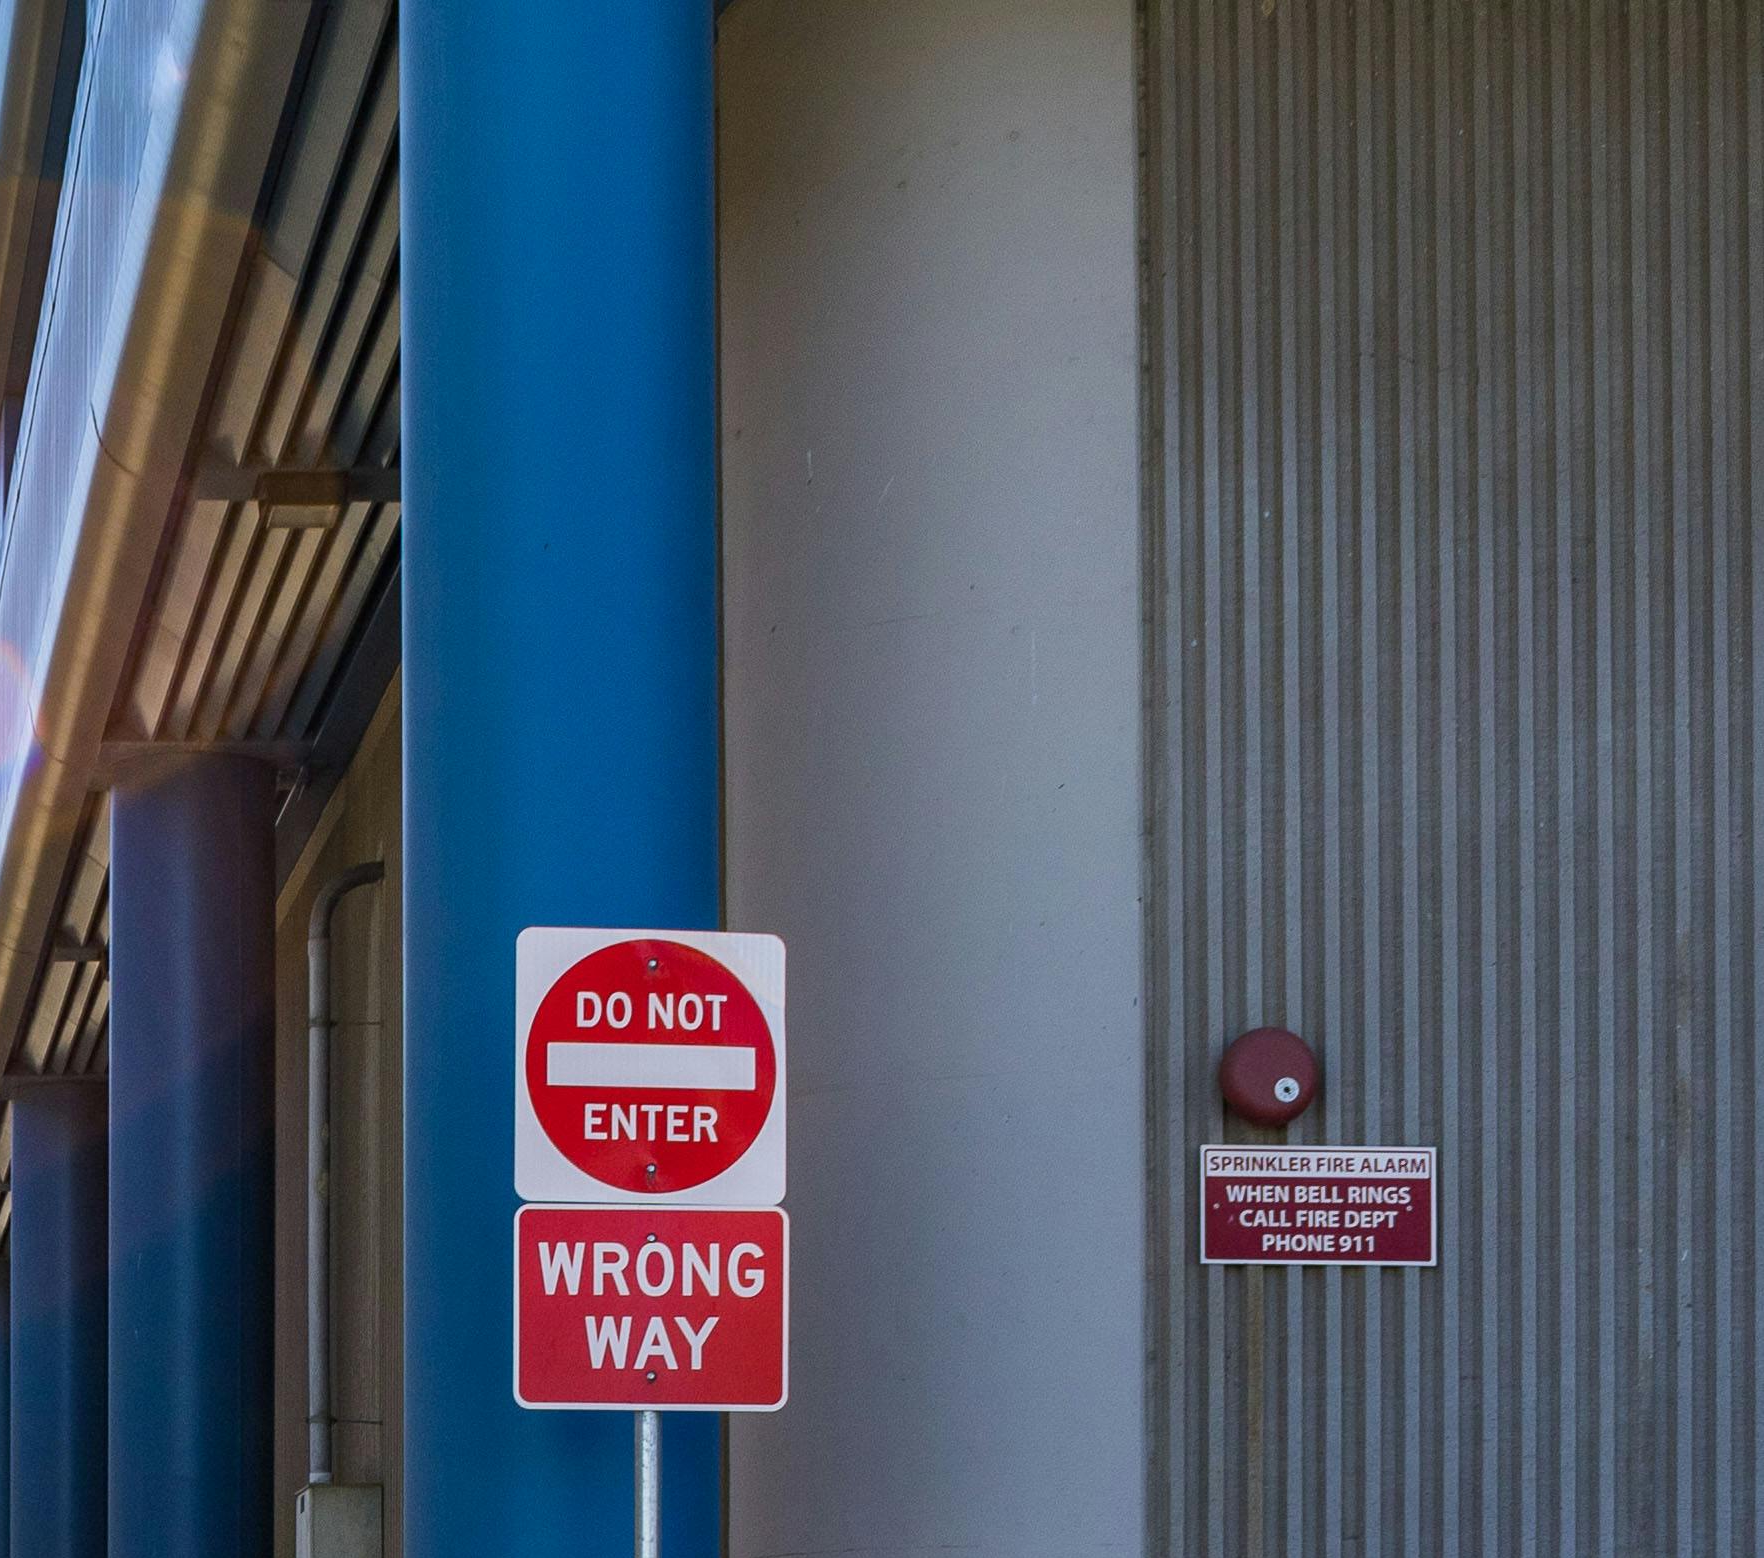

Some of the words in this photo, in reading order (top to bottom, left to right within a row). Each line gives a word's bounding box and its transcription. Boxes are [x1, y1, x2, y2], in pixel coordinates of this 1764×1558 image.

[575, 991, 633, 1029] DO
[647, 993, 728, 1031] NOT
[583, 1103, 719, 1143] ENTER
[1209, 1156, 1311, 1172] SPRINKLER
[1316, 1157, 1354, 1172] FIRE
[1360, 1158, 1426, 1173] ALARM
[1226, 1185, 1289, 1203] WHEN
[1294, 1186, 1343, 1203] BELL
[1347, 1186, 1411, 1204] RINGS
[1239, 1209, 1291, 1227] CALL
[1295, 1210, 1340, 1228] FIRE
[1344, 1211, 1398, 1228] DEPT
[1262, 1234, 1335, 1251] PHONE
[1339, 1235, 1376, 1252] 911
[538, 1241, 765, 1298] WRONG
[585, 1315, 720, 1370] WAY
